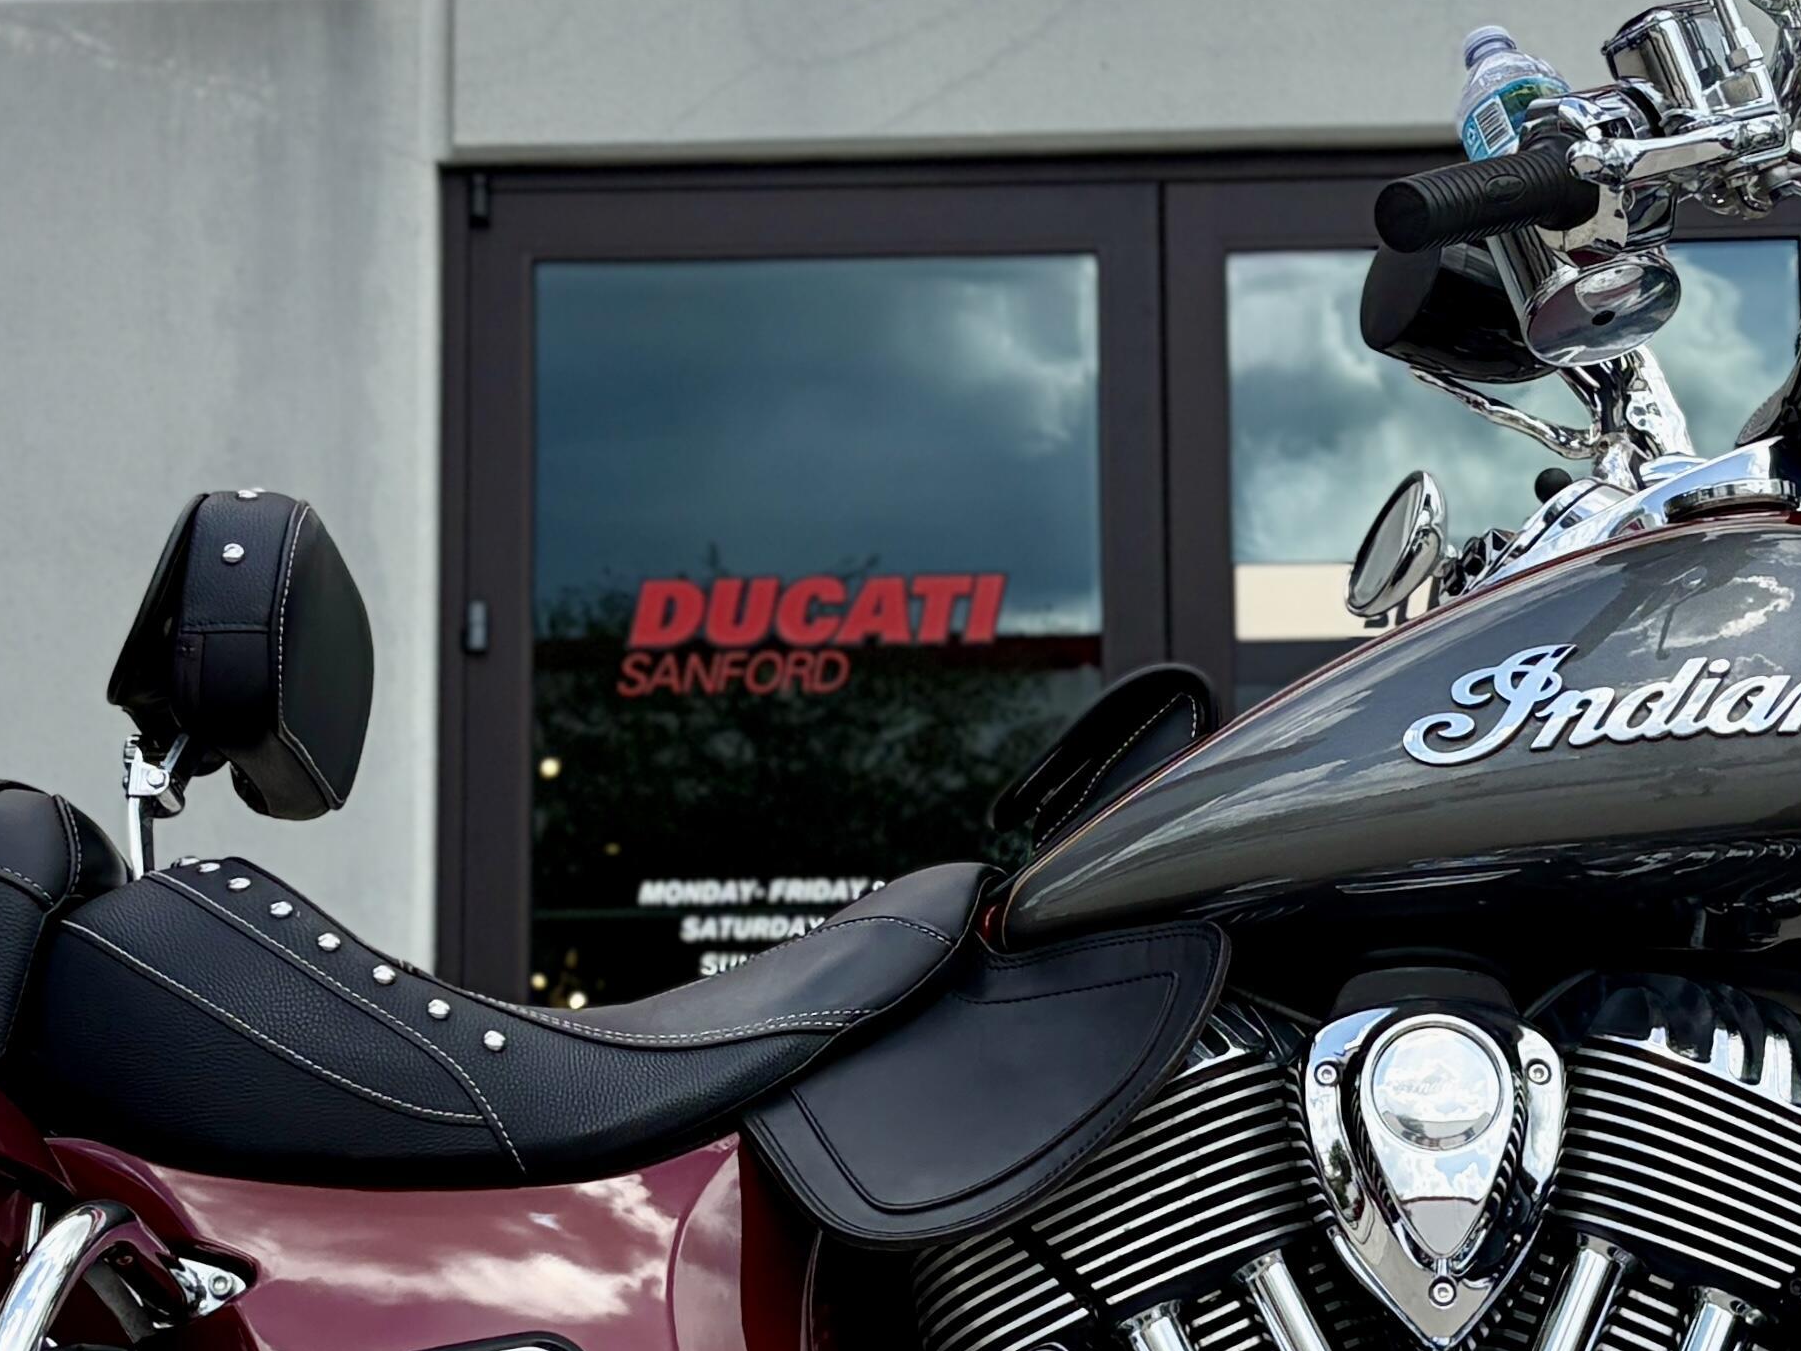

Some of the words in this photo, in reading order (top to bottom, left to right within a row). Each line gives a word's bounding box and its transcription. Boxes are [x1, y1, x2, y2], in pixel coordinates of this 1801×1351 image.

[627, 573, 1007, 647] DUCATI
[616, 650, 851, 697] SANFORD
[767, 876, 869, 903] FRIDAY
